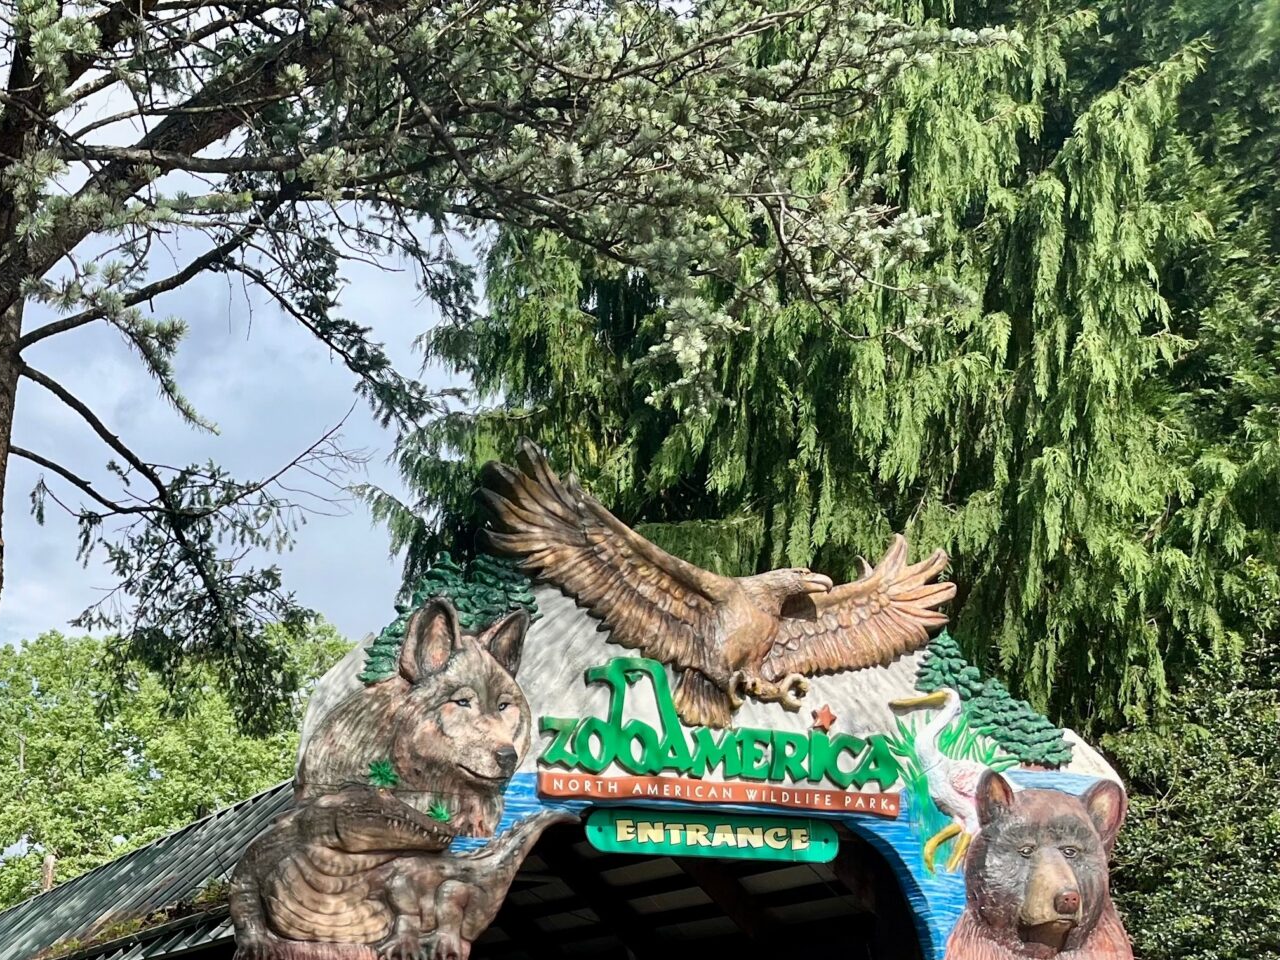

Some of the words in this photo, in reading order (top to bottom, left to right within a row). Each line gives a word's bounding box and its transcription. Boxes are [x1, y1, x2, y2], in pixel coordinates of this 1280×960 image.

[538, 656, 899, 791] ZOOAMERICA
[553, 778, 618, 793] NORTH
[632, 783, 732, 799] AMERICAN
[746, 789, 832, 806] WILDLIFE
[616, 819, 810, 851] ENTRANCE
